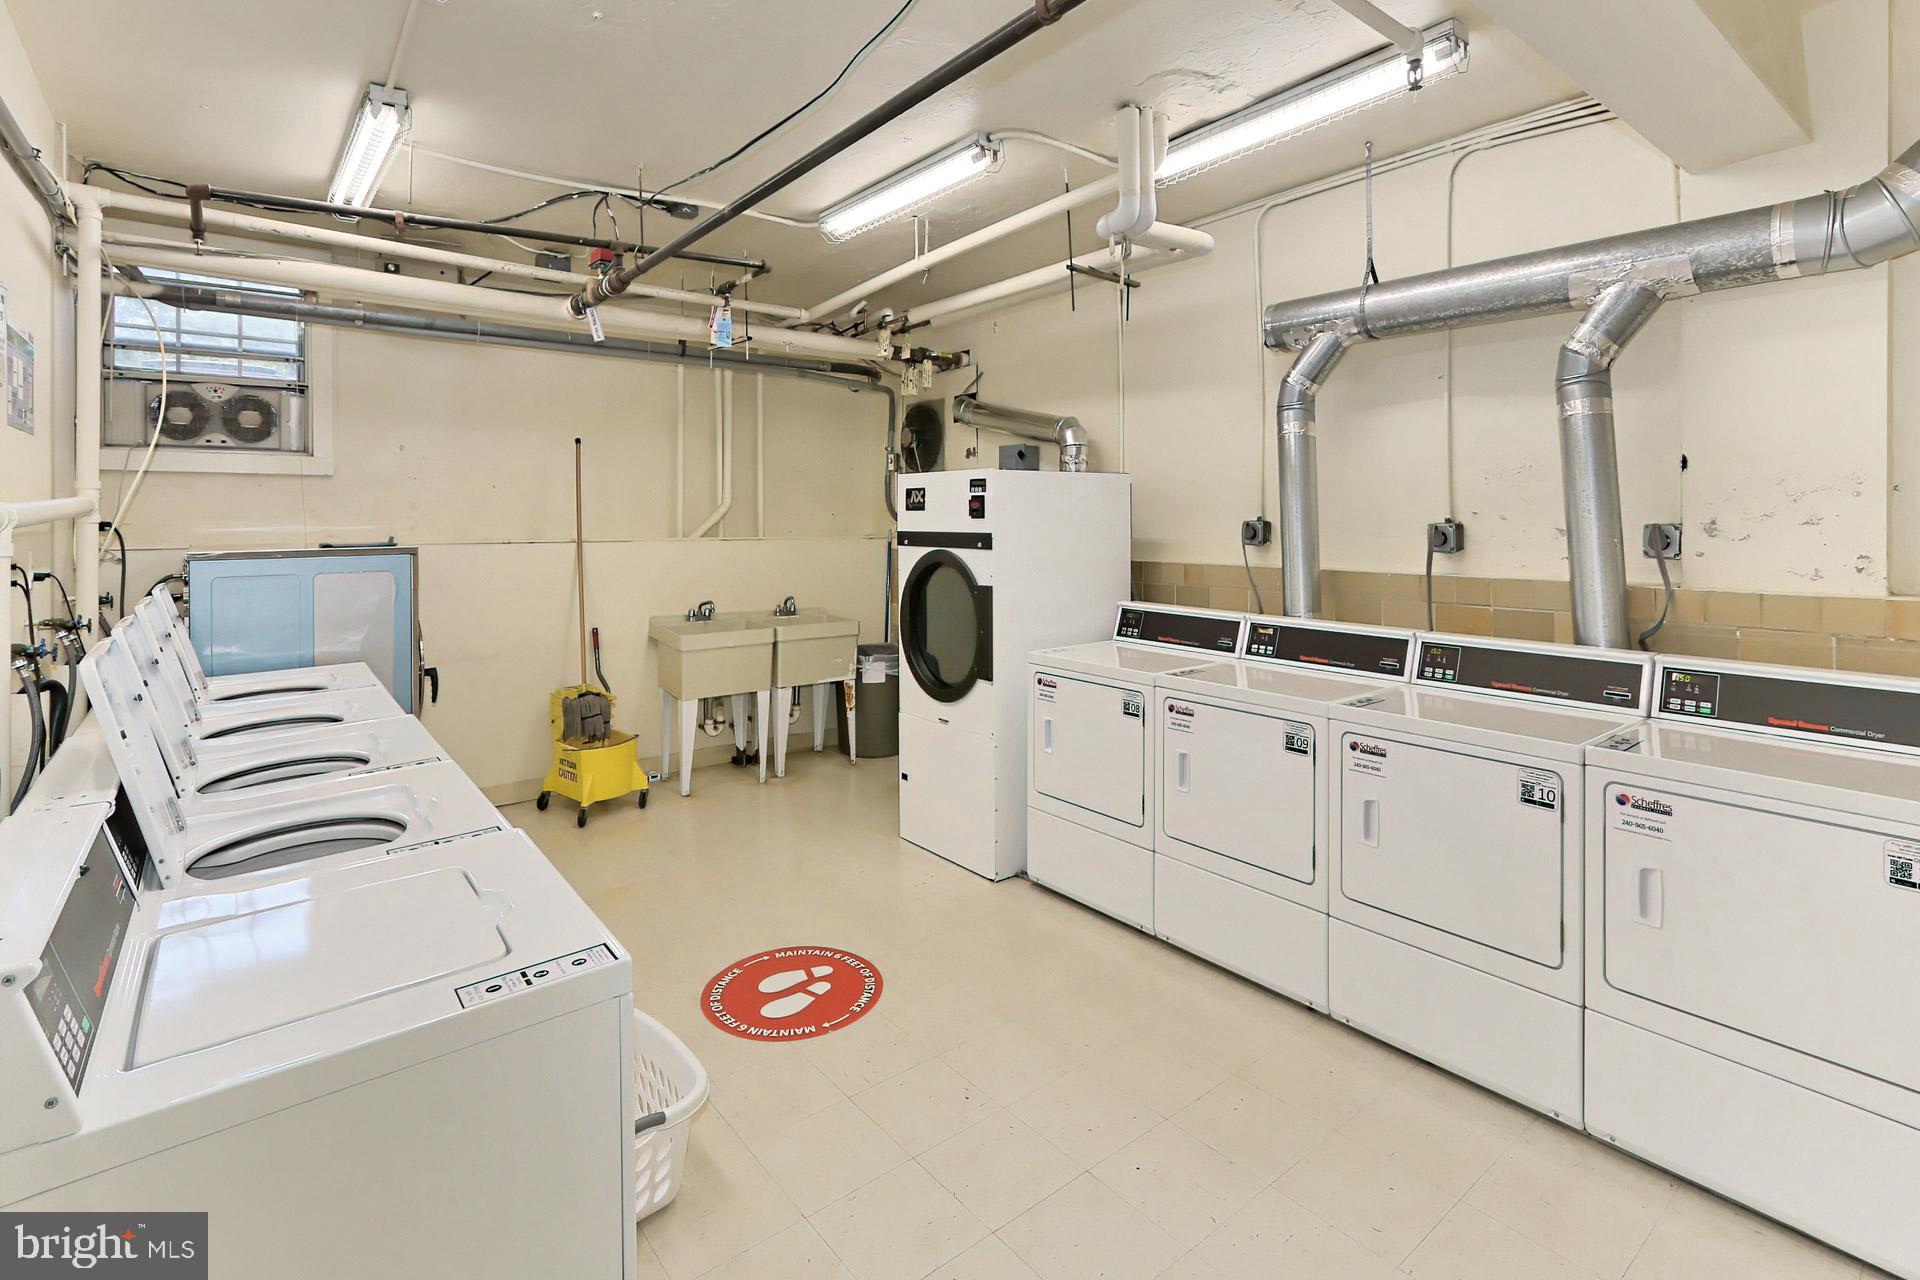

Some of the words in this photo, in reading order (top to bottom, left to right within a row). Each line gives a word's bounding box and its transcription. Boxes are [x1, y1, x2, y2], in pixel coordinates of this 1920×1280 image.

[1131, 703, 1140, 714] 08
[1830, 726, 1867, 737] Commercial
[1867, 730, 1886, 740] Dryer
[1296, 737, 1309, 749] 09
[1537, 788, 1556, 803] 10
[1631, 795, 1673, 812] Scheffres
[775, 949, 834, 959] MAINTAIN
[841, 954, 865, 970] FEET
[710, 967, 743, 1001] DISTANCE
[849, 976, 876, 1013] DISTANCE
[715, 1013, 740, 1030] FEET
[747, 1025, 817, 1037] MAINTAIN
